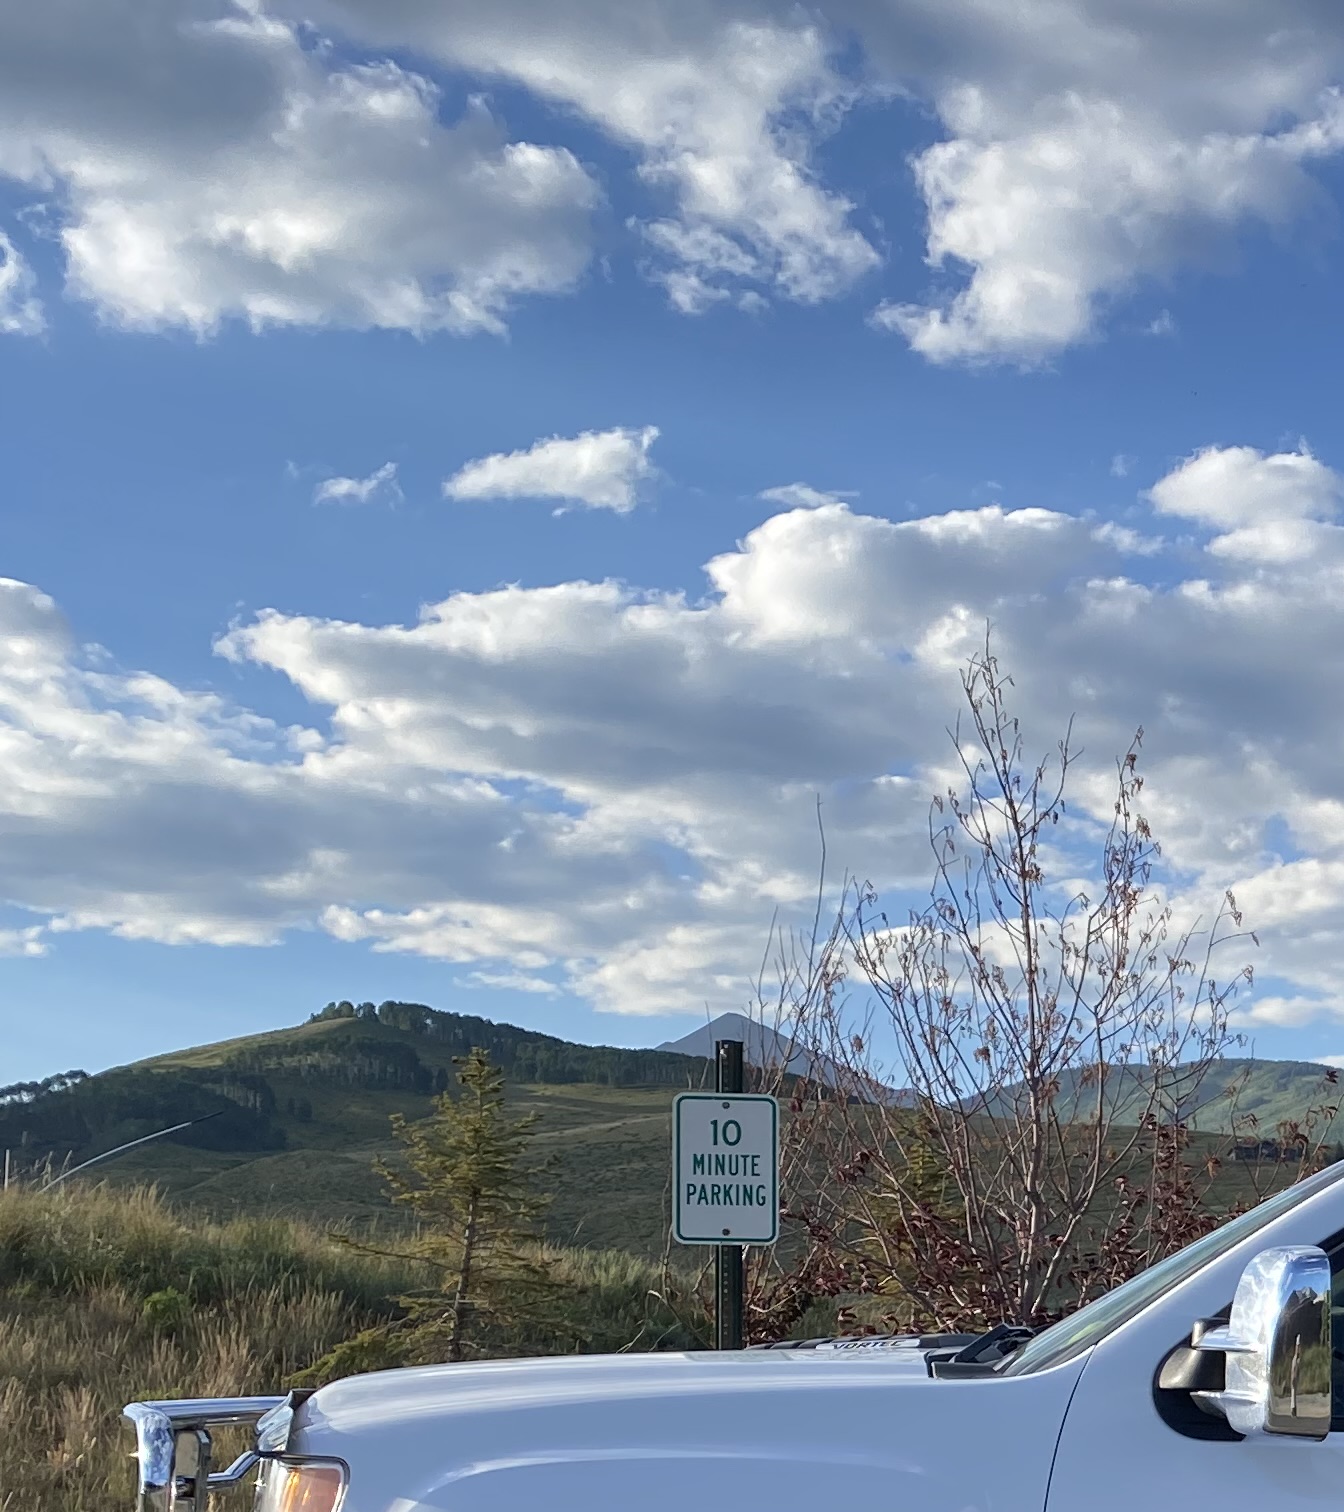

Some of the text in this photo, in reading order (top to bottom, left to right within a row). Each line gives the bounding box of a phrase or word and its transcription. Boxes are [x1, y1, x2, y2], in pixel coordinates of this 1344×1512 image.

[710, 1119, 742, 1147] 10
[692, 1153, 761, 1177] MINUTE
[686, 1183, 766, 1207] PARKING
